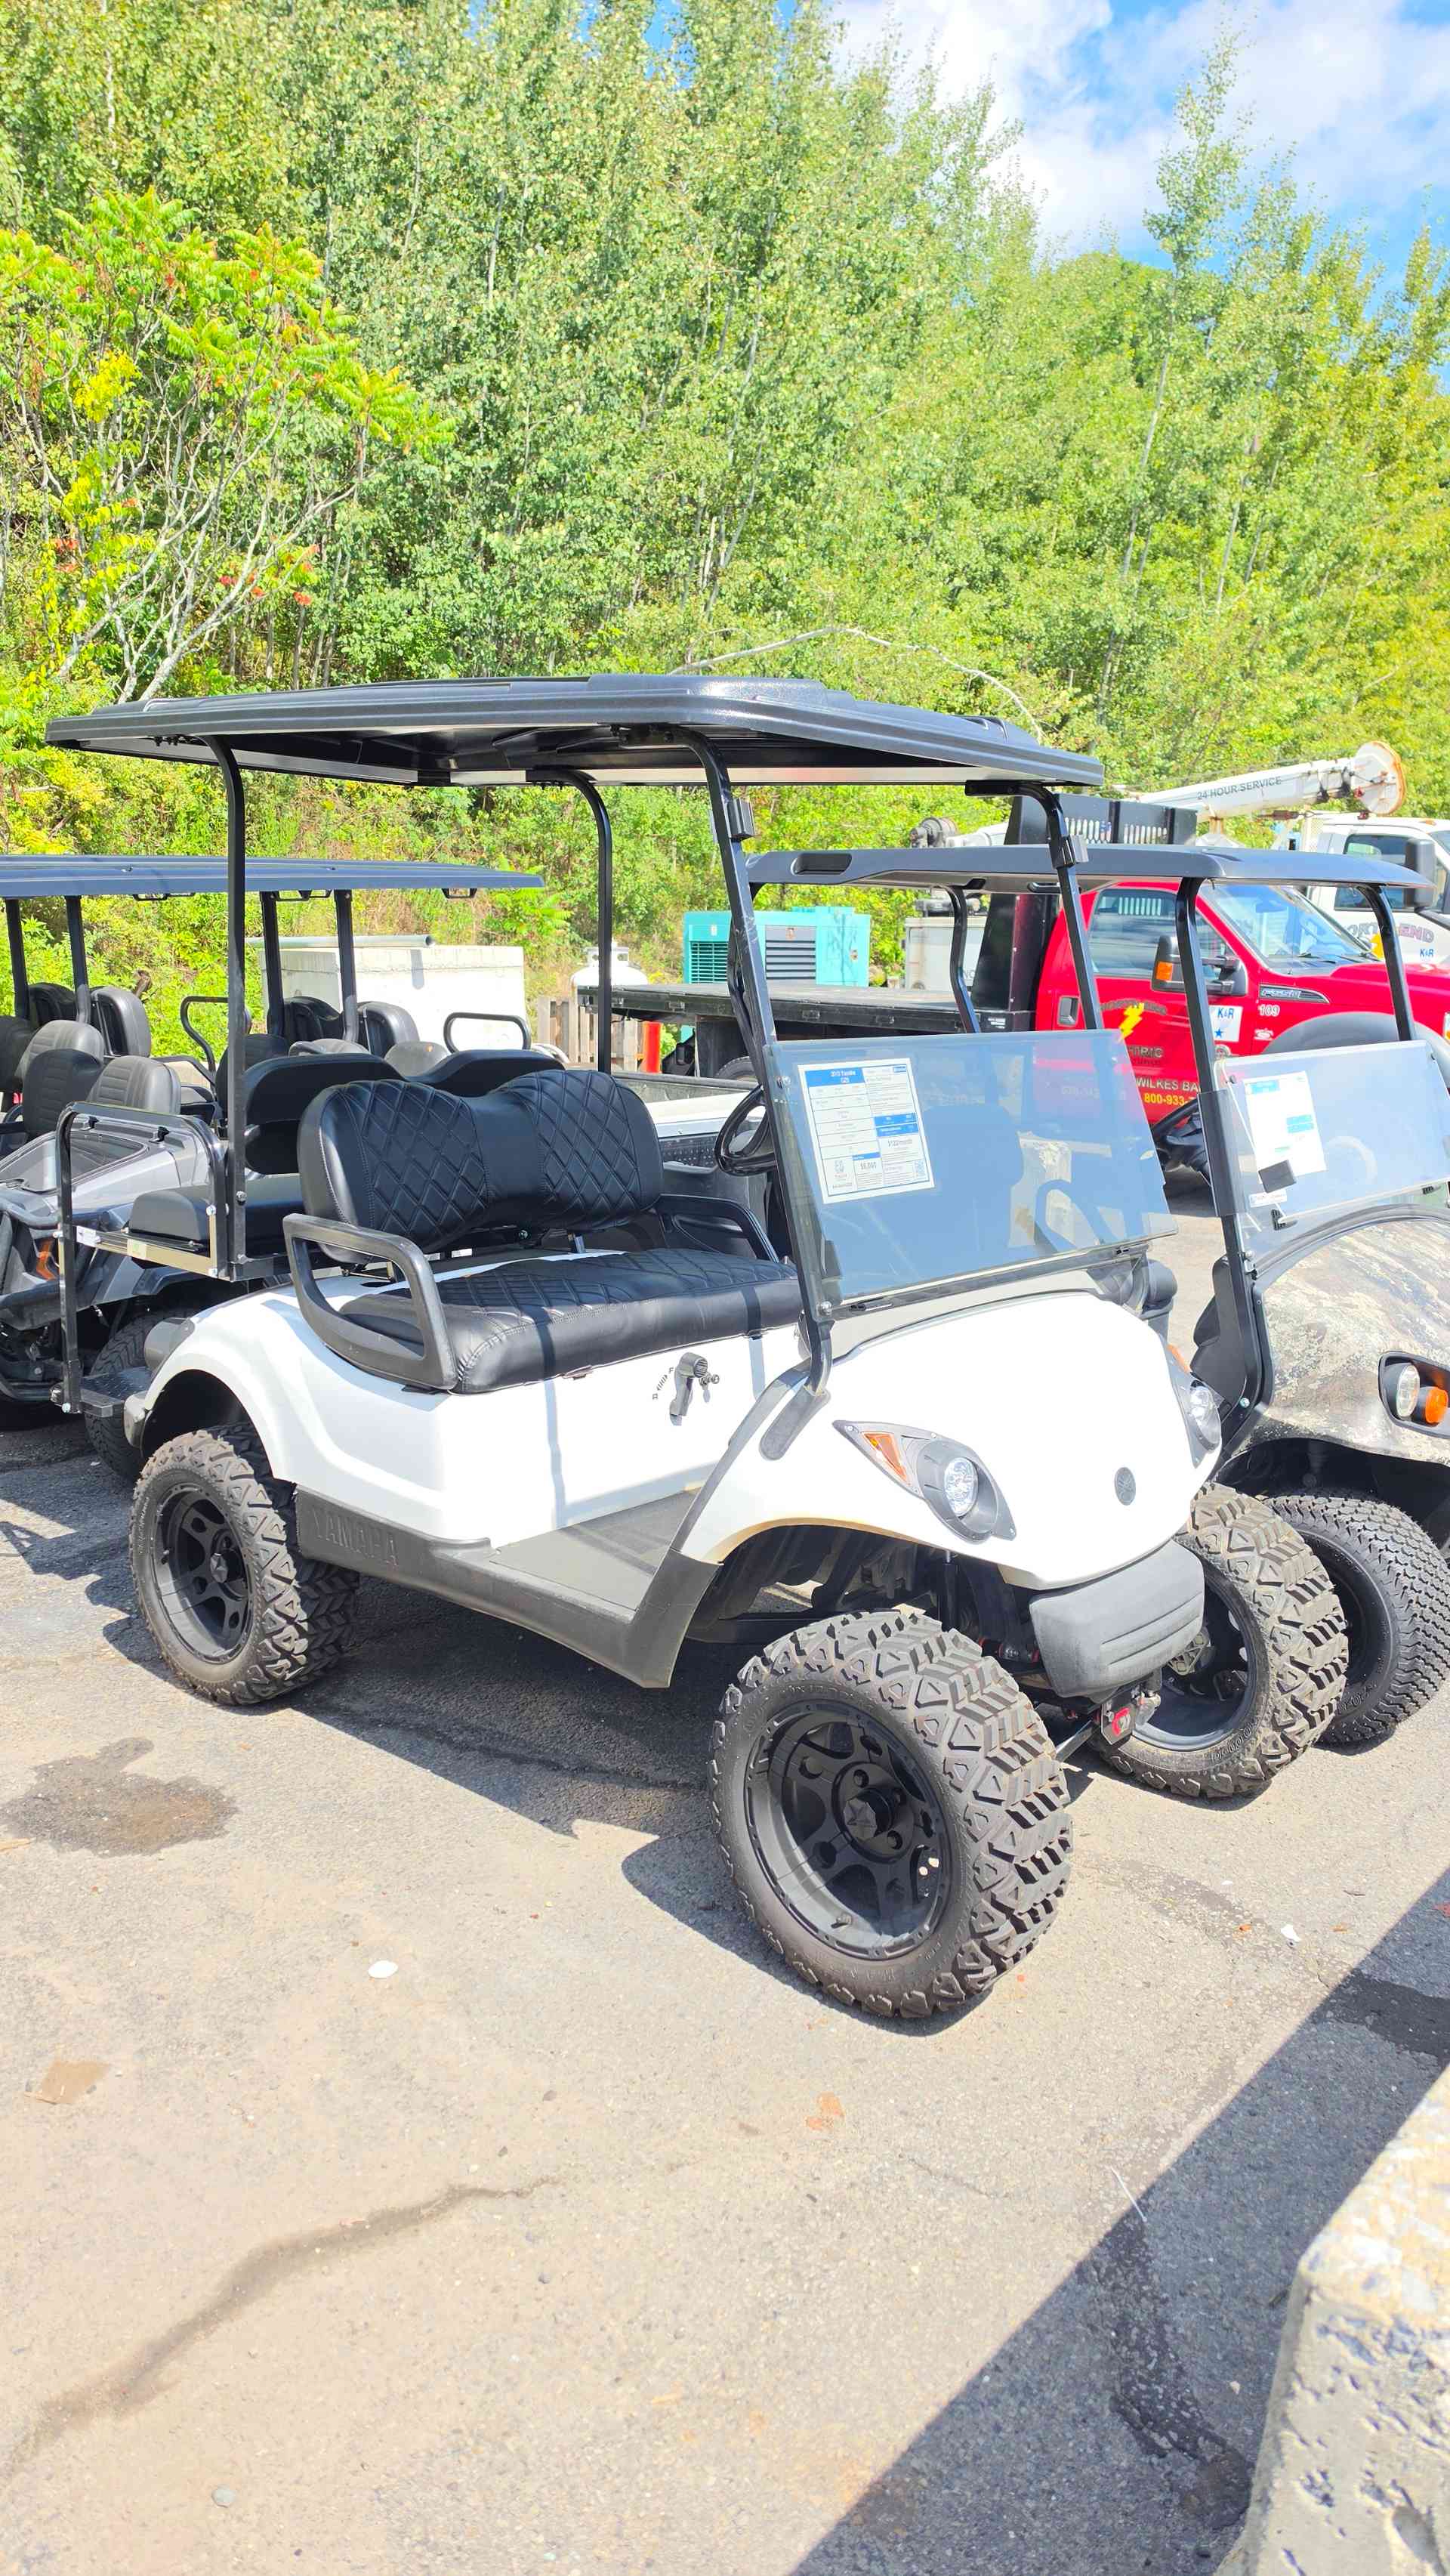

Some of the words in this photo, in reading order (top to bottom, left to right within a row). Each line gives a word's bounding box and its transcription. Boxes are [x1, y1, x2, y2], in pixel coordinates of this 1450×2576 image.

[1197, 791, 1208, 799] 24
[1210, 785, 1239, 798] HOUR
[1239, 776, 1282, 792] SERVICE
[1399, 923, 1434, 944] END
[1217, 1007, 1234, 1019] K&R
[1136, 1076, 1178, 1091] WILKES
[1182, 1081, 1201, 1092] BA
